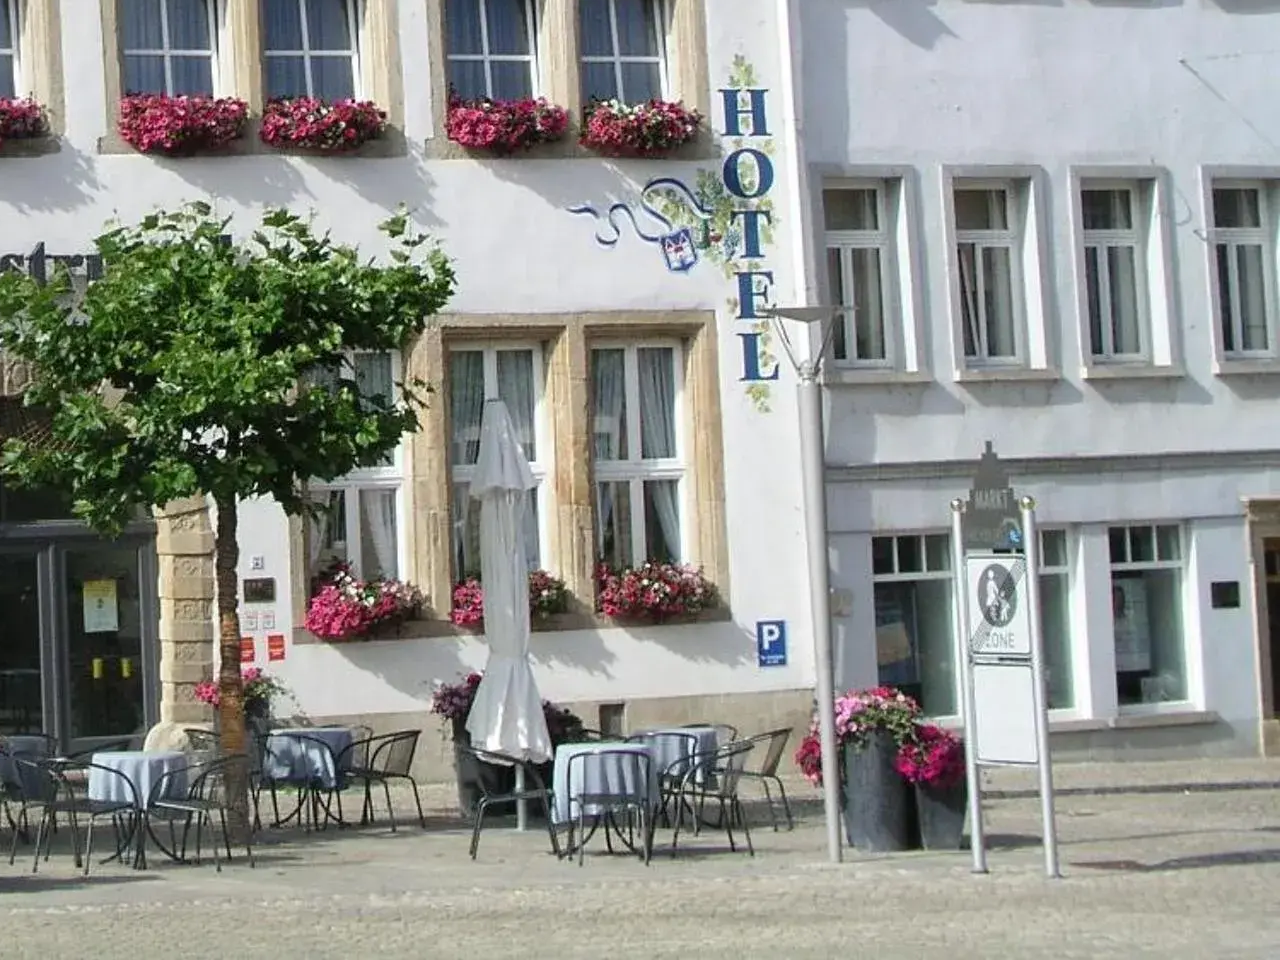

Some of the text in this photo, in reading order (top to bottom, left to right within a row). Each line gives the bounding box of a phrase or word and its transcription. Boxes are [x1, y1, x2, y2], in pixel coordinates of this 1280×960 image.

[718, 88, 779, 381] HOTEL
[974, 489, 1008, 510] MARKT
[762, 624, 780, 650] P
